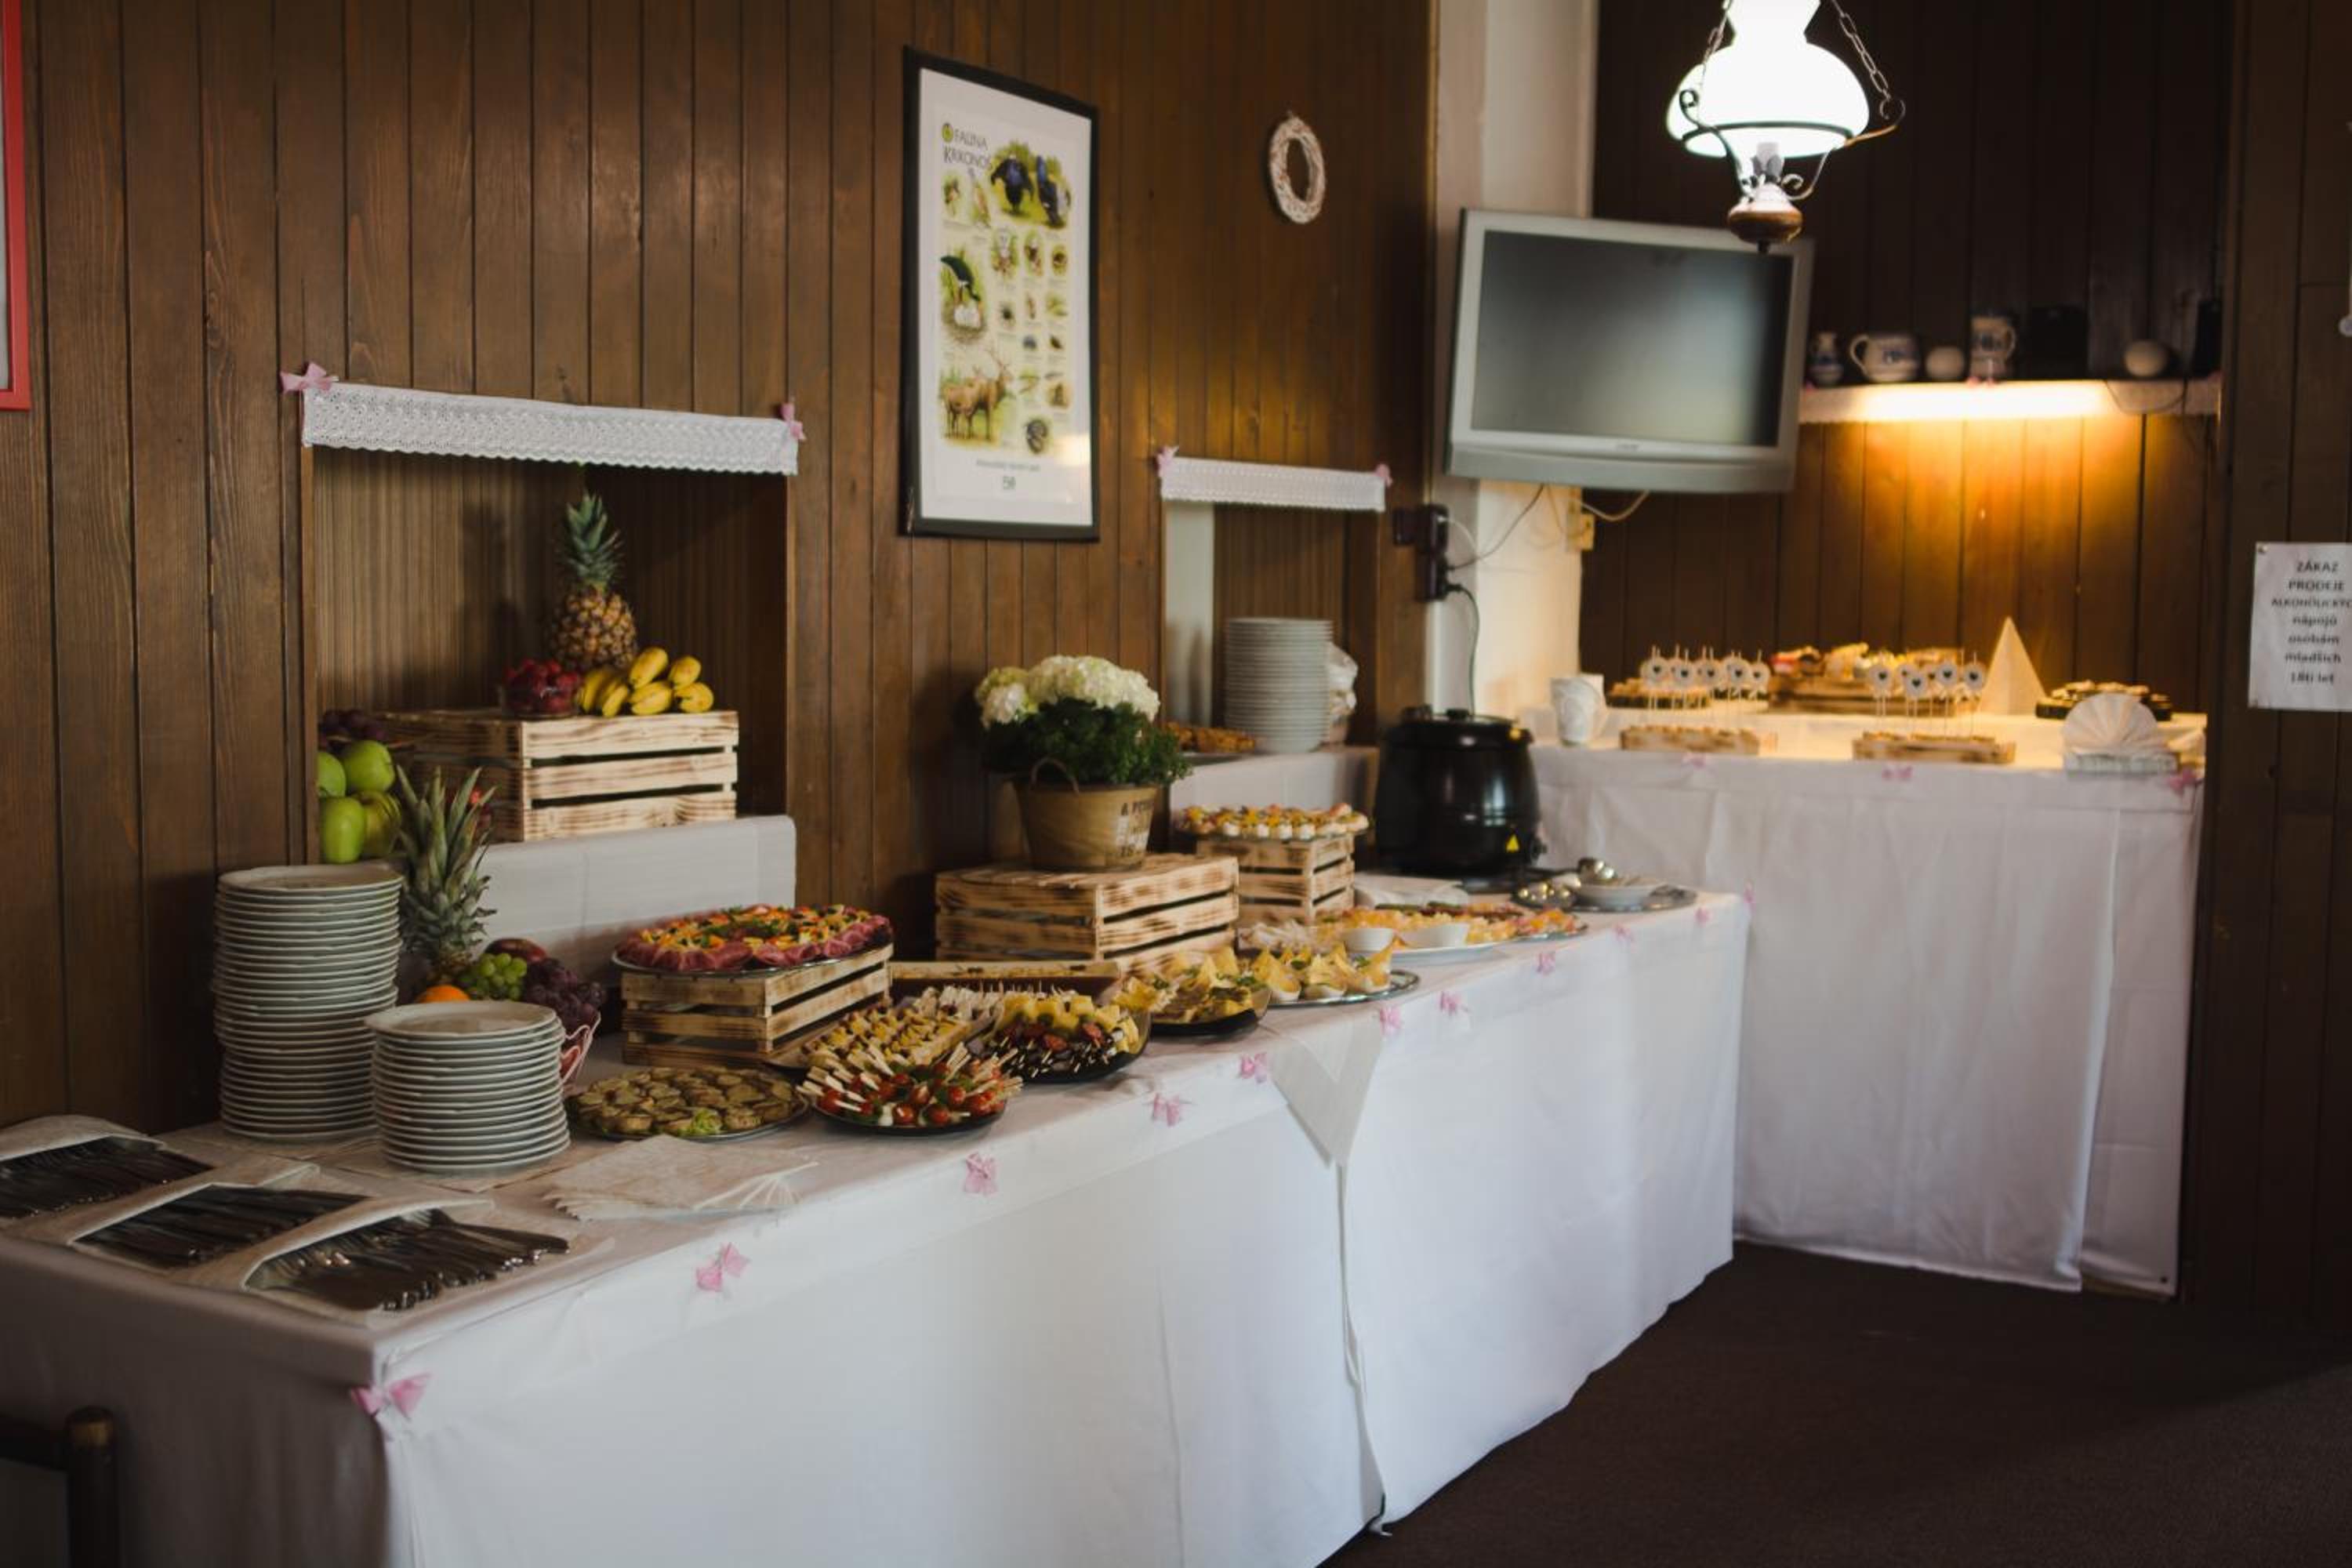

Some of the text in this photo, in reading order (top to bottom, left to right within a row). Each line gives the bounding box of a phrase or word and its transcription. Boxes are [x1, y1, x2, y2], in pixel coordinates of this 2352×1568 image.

[954, 128, 989, 151] FAUNA
[2296, 560, 2339, 573] ZÁKAZ
[2288, 580, 2344, 590] PRODEJE
